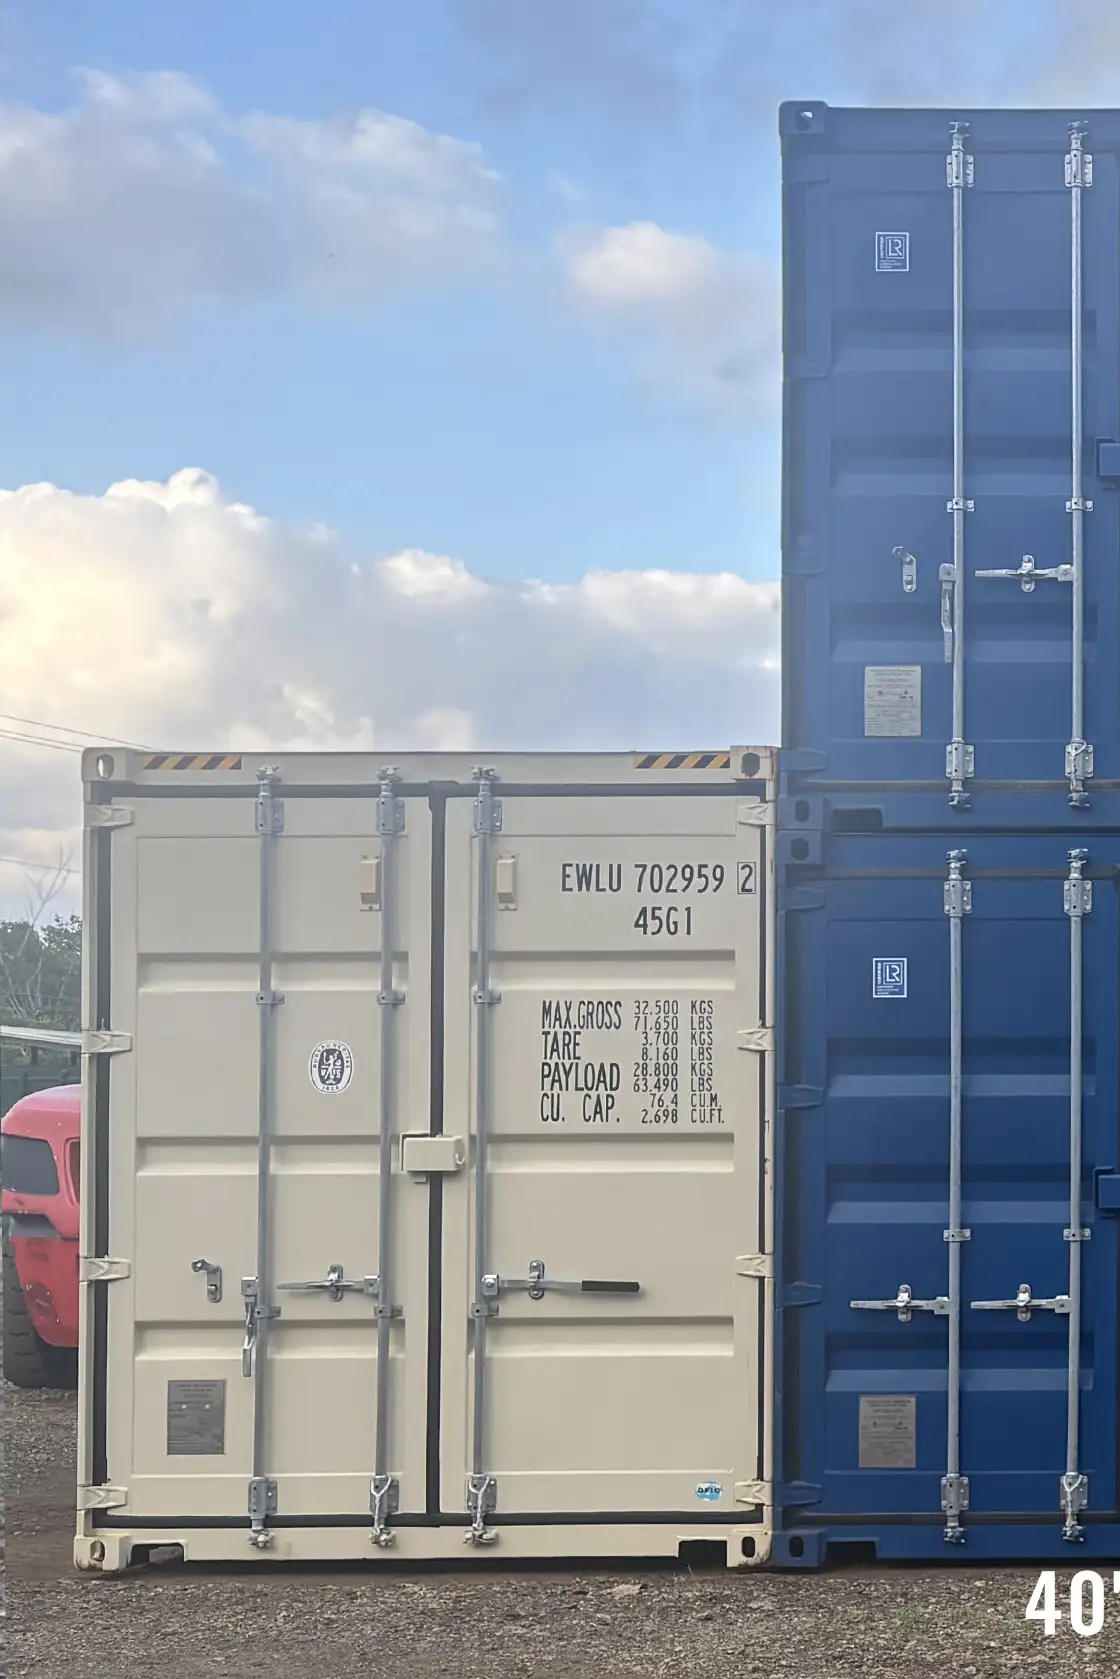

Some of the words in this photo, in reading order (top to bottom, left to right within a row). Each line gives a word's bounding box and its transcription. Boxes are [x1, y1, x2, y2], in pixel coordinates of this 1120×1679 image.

[561, 862, 622, 892] EWLU
[633, 864, 725, 894] 702959
[739, 864, 754, 893] 2
[634, 906, 692, 936] 45G1
[541, 1000, 623, 1030] MAX.GROSS
[633, 1000, 680, 1016] 32.500
[690, 1000, 714, 1016] KGS
[633, 1015, 680, 1031] 71.650
[690, 1015, 713, 1031] LBS
[541, 1030, 582, 1061] TARE
[642, 1031, 680, 1047] 3.700
[690, 1031, 714, 1047] KGS
[641, 1046, 679, 1062] 8.160
[690, 1046, 713, 1062] LBS
[540, 1062, 621, 1092] PAYLOAD
[633, 1062, 679, 1078] 28.800
[690, 1062, 714, 1078] KGS
[632, 1077, 679, 1093] 63.490
[690, 1077, 713, 1093] LBS
[540, 1092, 566, 1122] CU.
[582, 1092, 620, 1123] CAP.
[650, 1092, 678, 1108] 76.4
[690, 1092, 722, 1108] CU.M.
[641, 1108, 678, 1124] 2.698
[690, 1108, 725, 1124] CU.FT.
